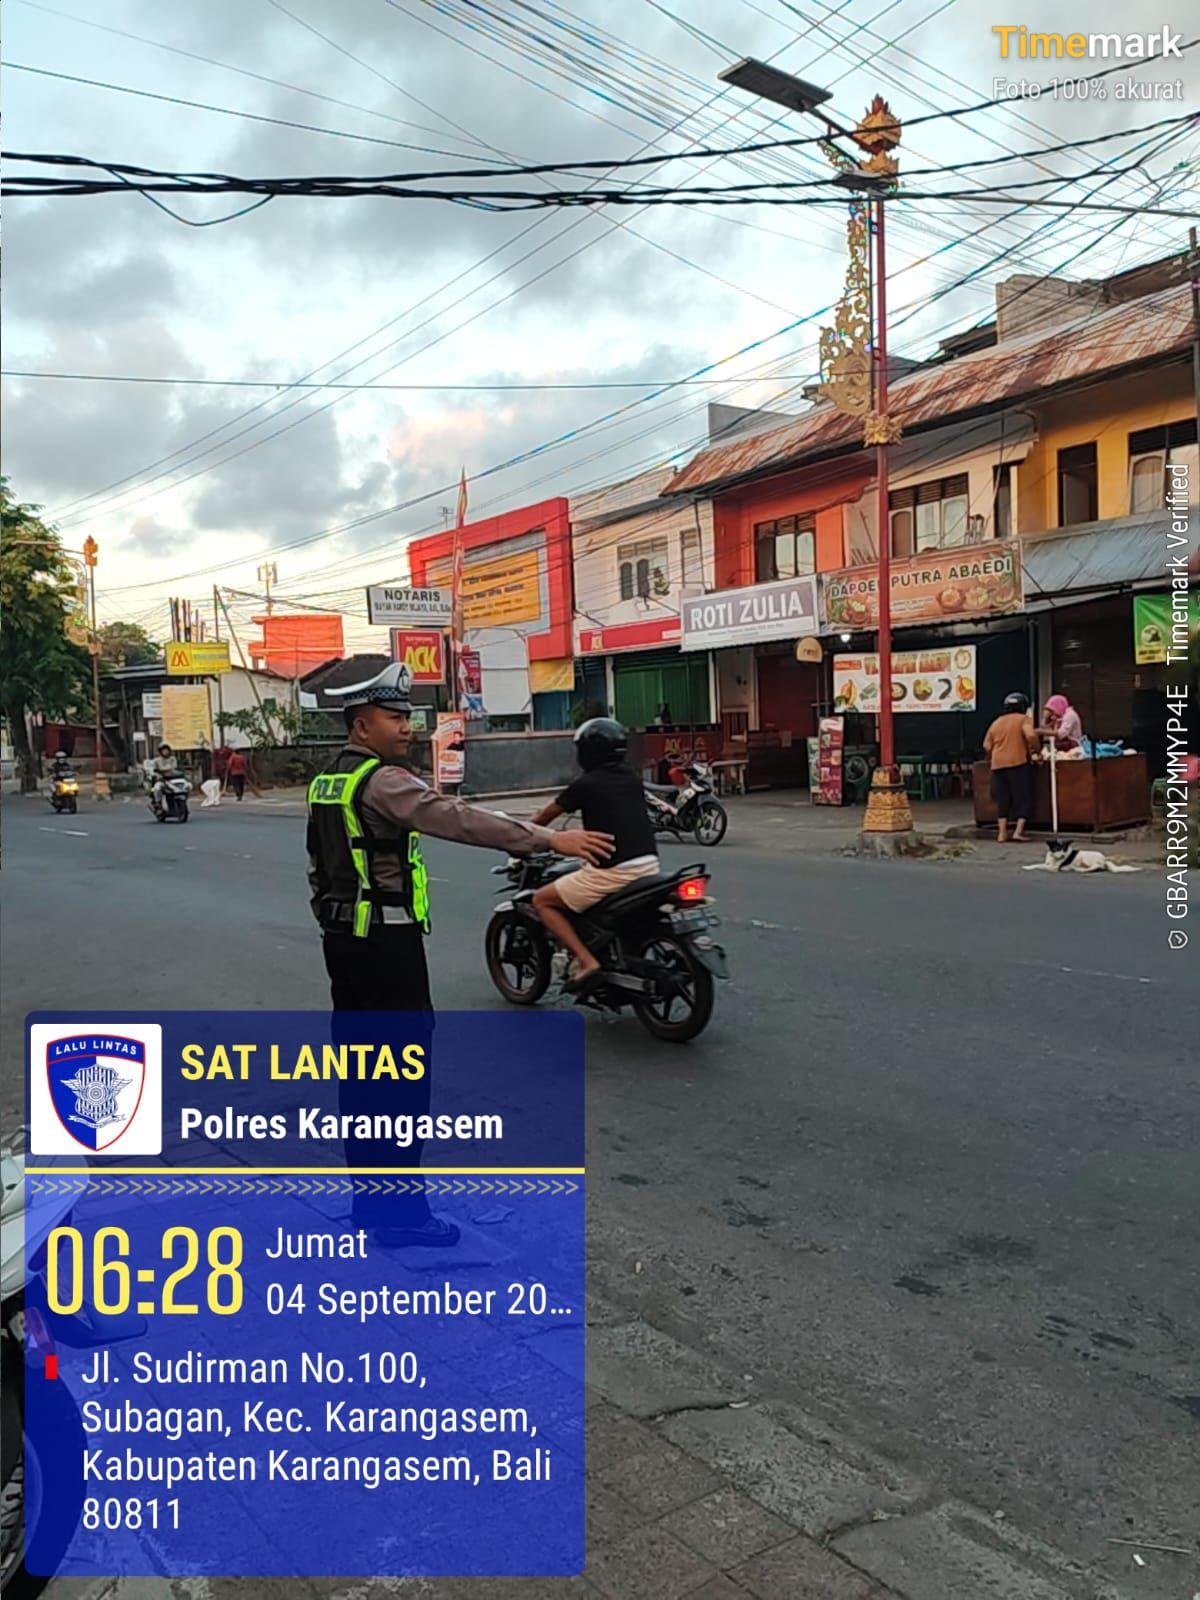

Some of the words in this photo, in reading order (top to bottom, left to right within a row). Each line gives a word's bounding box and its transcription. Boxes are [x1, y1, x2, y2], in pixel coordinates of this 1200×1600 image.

[830, 579, 878, 598] DAPOE
[891, 570, 942, 589] PUTRA
[948, 556, 1013, 579] ABAEDI
[384, 589, 441, 602] NOTARIS
[690, 602, 733, 631] ROTI
[739, 590, 804, 623] ZULIA
[404, 645, 439, 674] ACK
